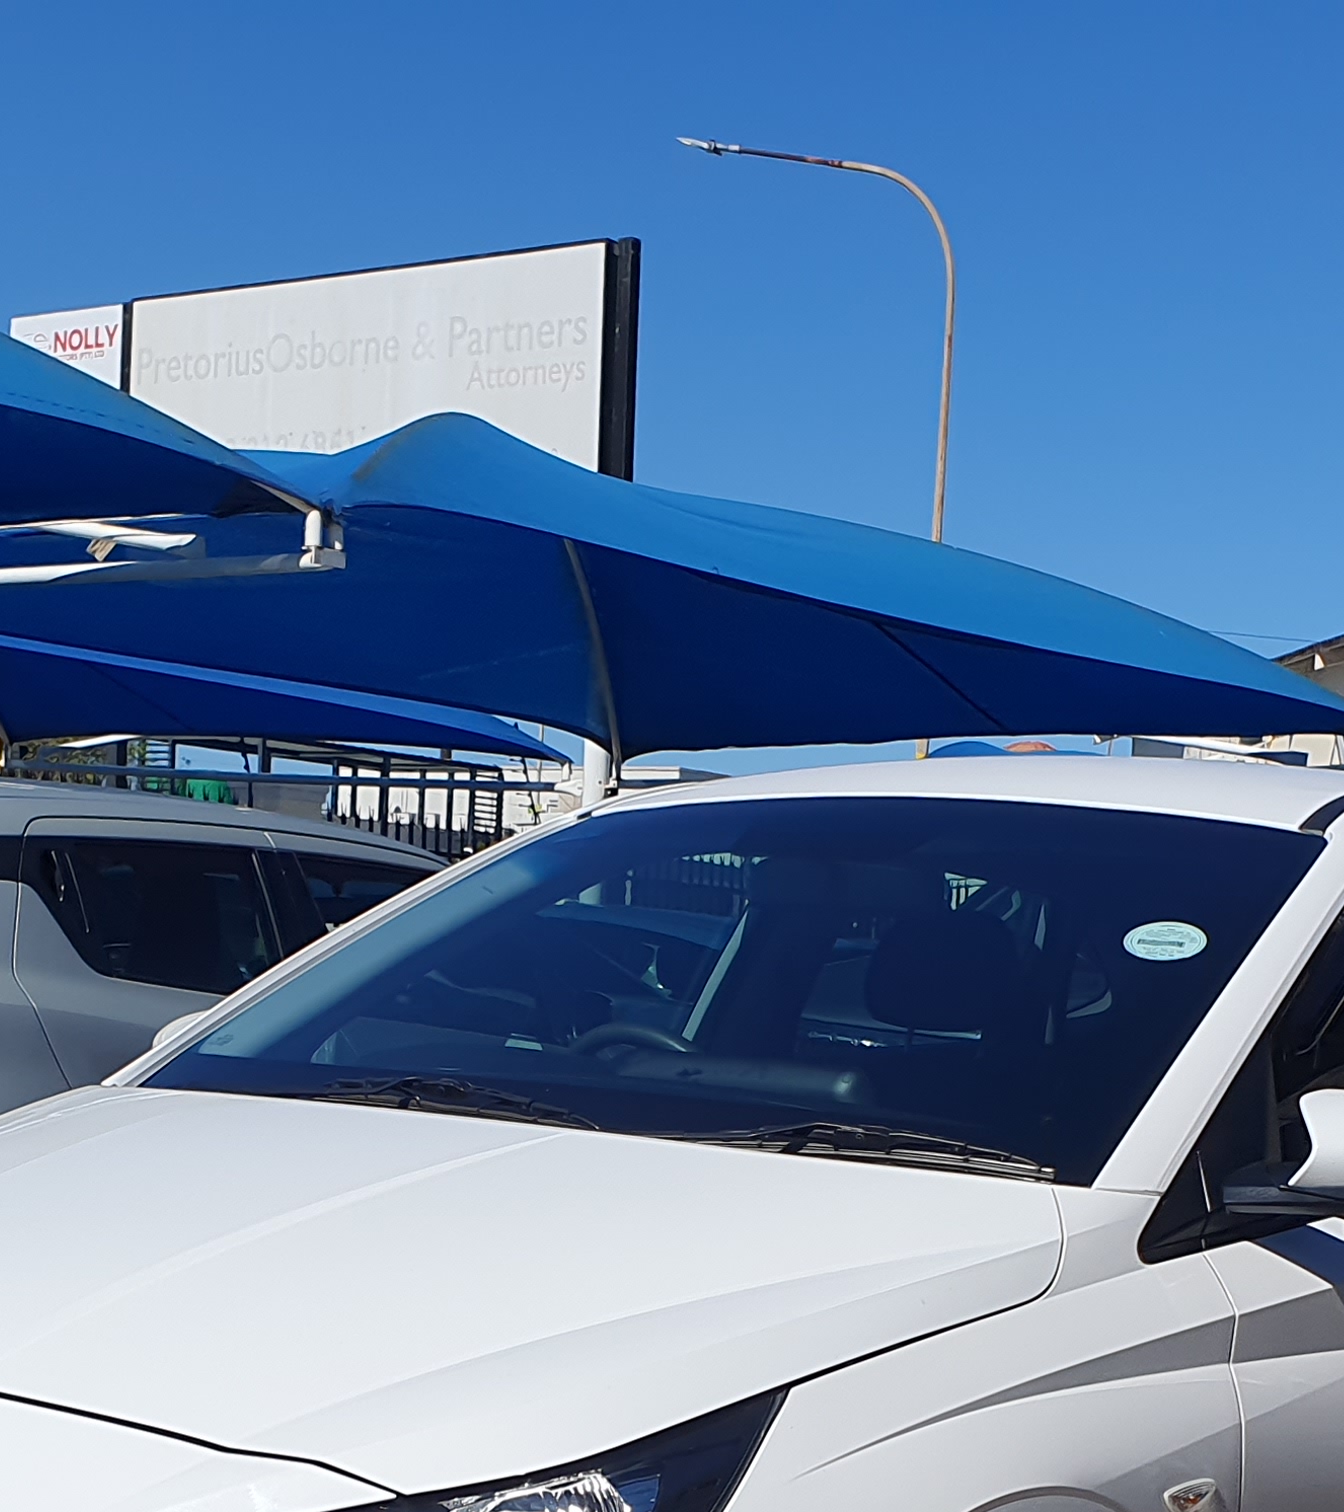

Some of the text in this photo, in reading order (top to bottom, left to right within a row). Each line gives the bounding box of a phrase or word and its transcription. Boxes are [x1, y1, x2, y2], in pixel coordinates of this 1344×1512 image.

[53, 323, 119, 353] NOLLY
[412, 321, 435, 361] &
[448, 315, 588, 358] Partners
[465, 360, 587, 392] Attorneys
